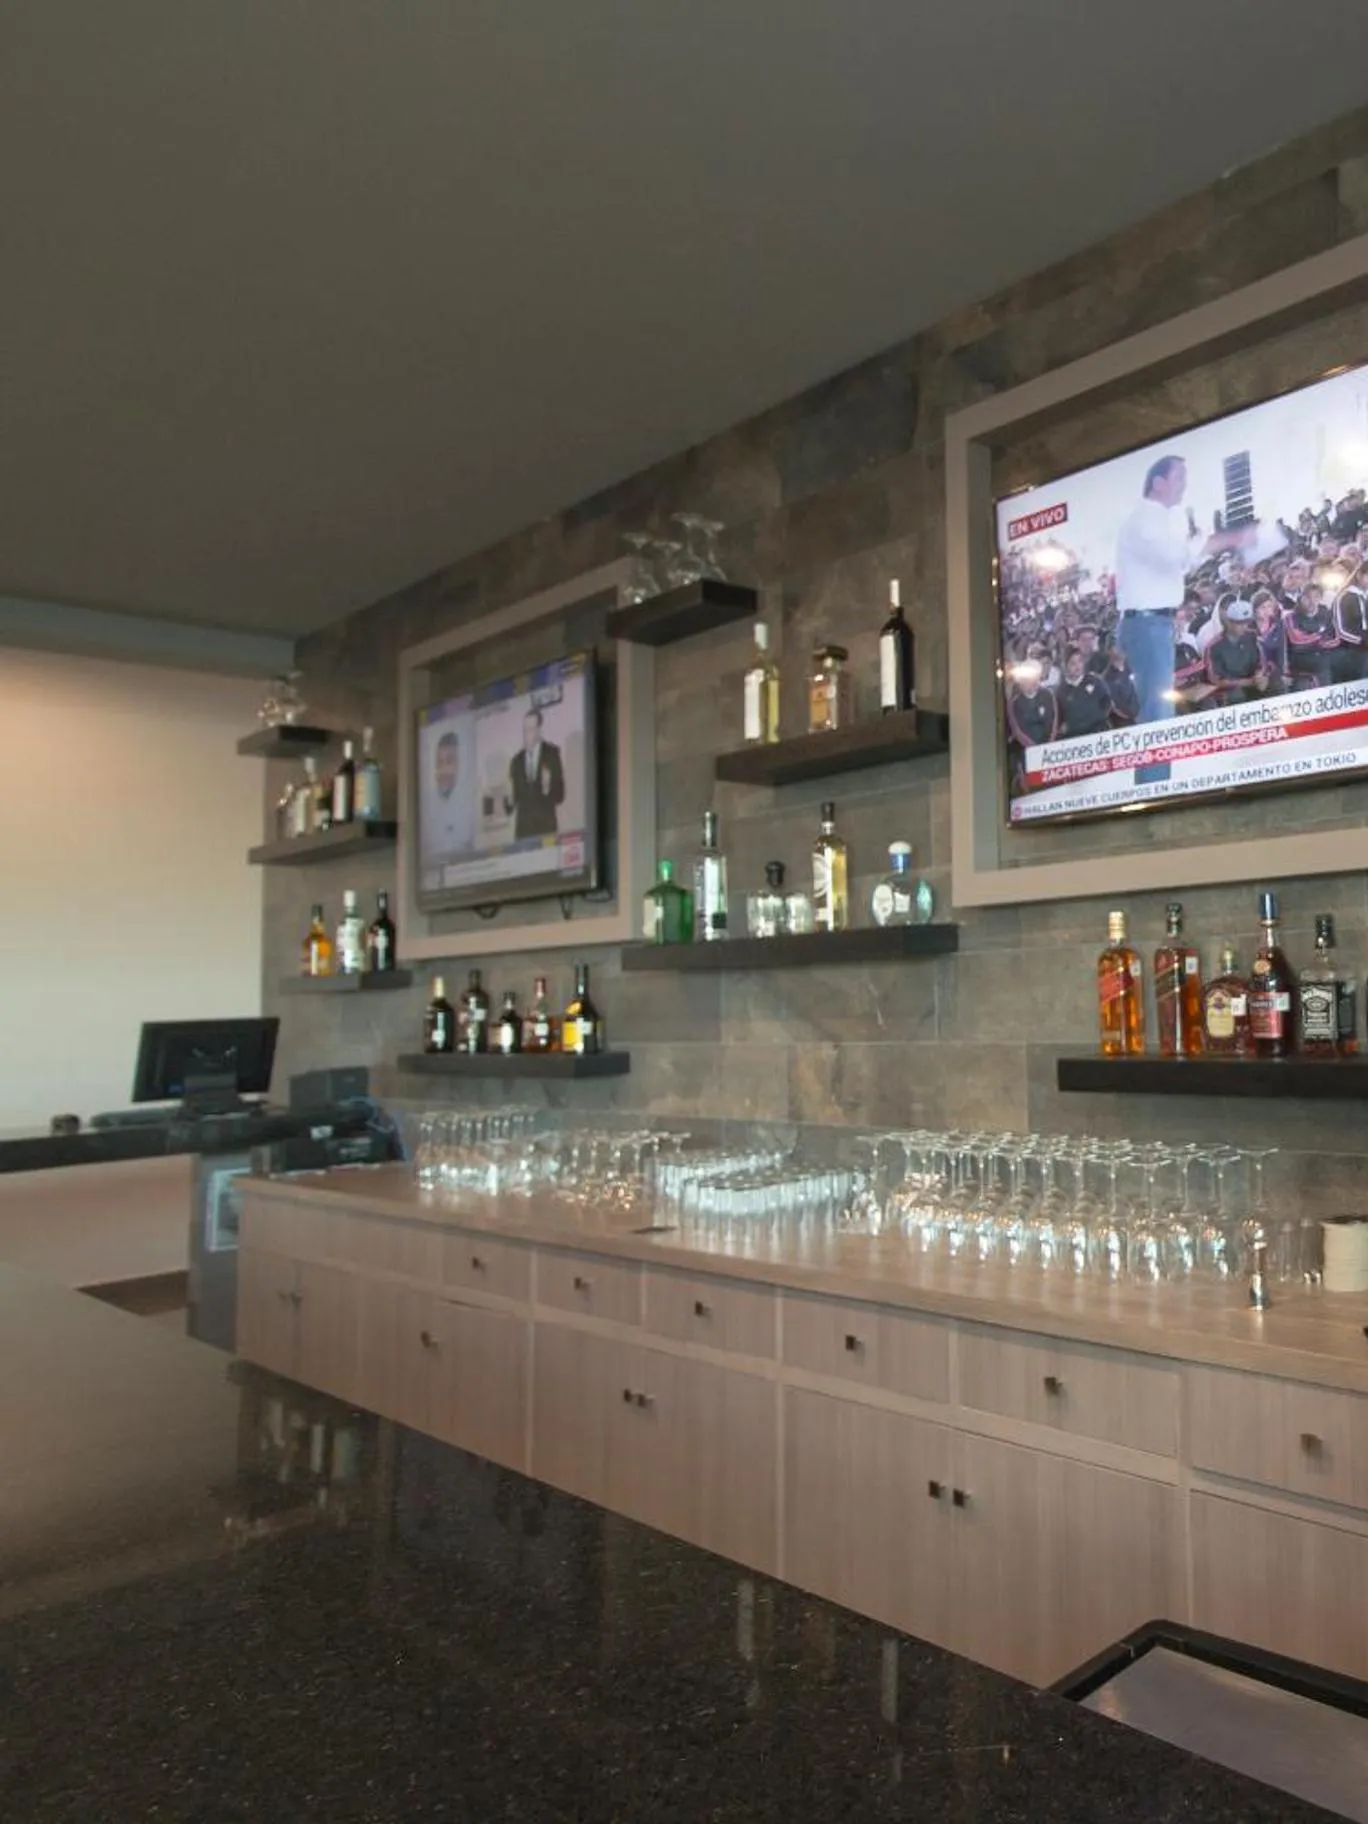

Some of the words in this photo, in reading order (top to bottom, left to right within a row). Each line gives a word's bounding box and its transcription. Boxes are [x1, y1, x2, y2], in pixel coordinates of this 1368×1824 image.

[1010, 518, 1029, 538] EN
[1030, 506, 1065, 530] VIVO
[1042, 742, 1094, 765] Acciones
[1096, 735, 1111, 755] de
[1112, 732, 1132, 751] PC
[1216, 708, 1237, 733] del
[1154, 783, 1169, 794] EN
[1172, 780, 1189, 791] UN
[1190, 763, 1293, 789] DEPARTAMENTO
[1294, 760, 1313, 772] EN
[1316, 751, 1358, 769] TOKIO
